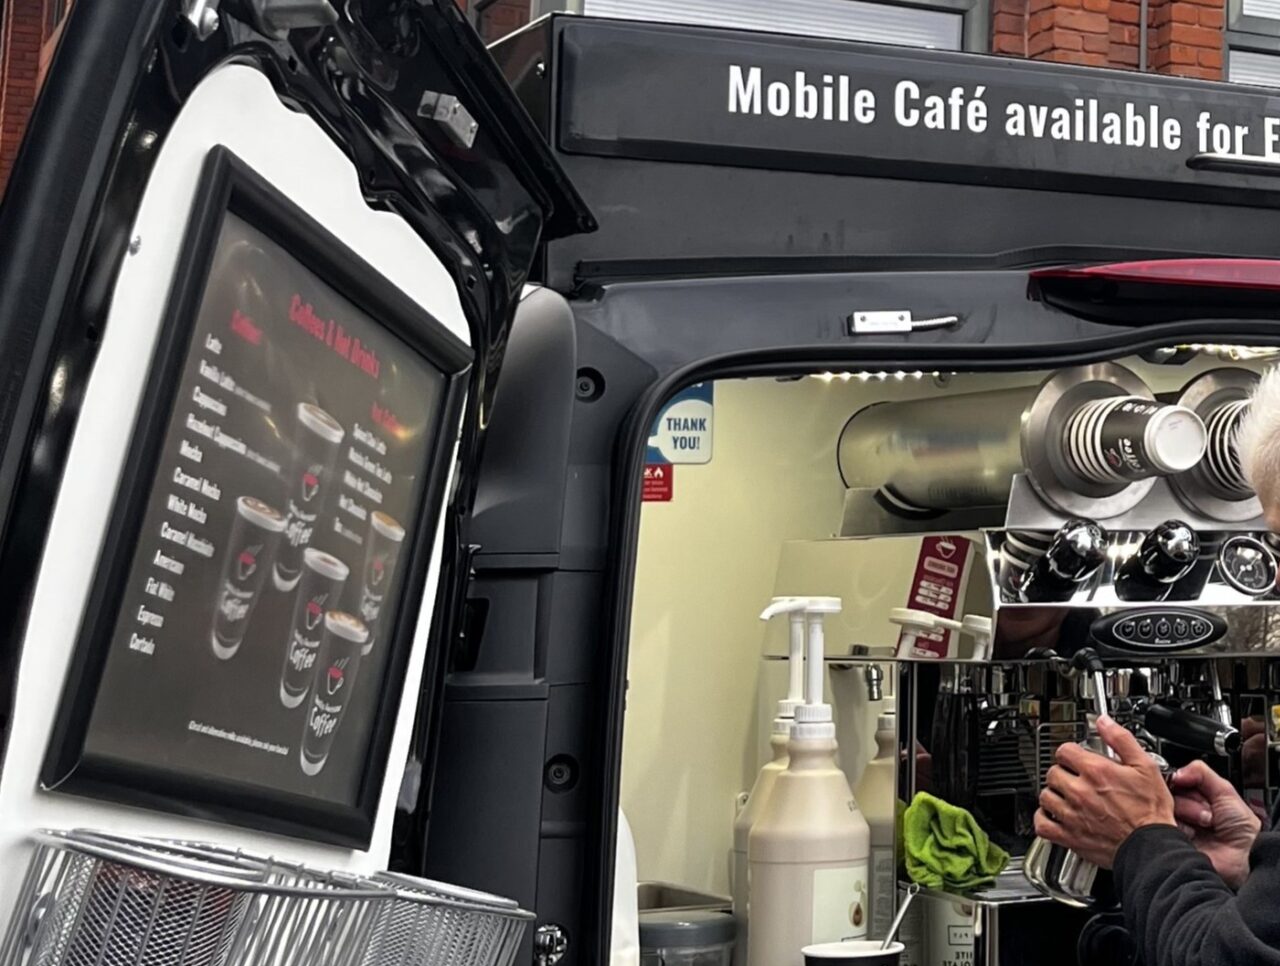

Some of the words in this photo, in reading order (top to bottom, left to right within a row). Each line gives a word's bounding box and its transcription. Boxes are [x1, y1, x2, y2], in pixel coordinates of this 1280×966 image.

[728, 65, 876, 124] Mobile
[895, 80, 988, 133] Café
[1005, 98, 1182, 151] available
[1197, 112, 1249, 155] for
[666, 417, 707, 432] THANK
[672, 436, 700, 449] YOU!
[289, 640, 316, 672] Coffee
[310, 706, 337, 738] Coffee
